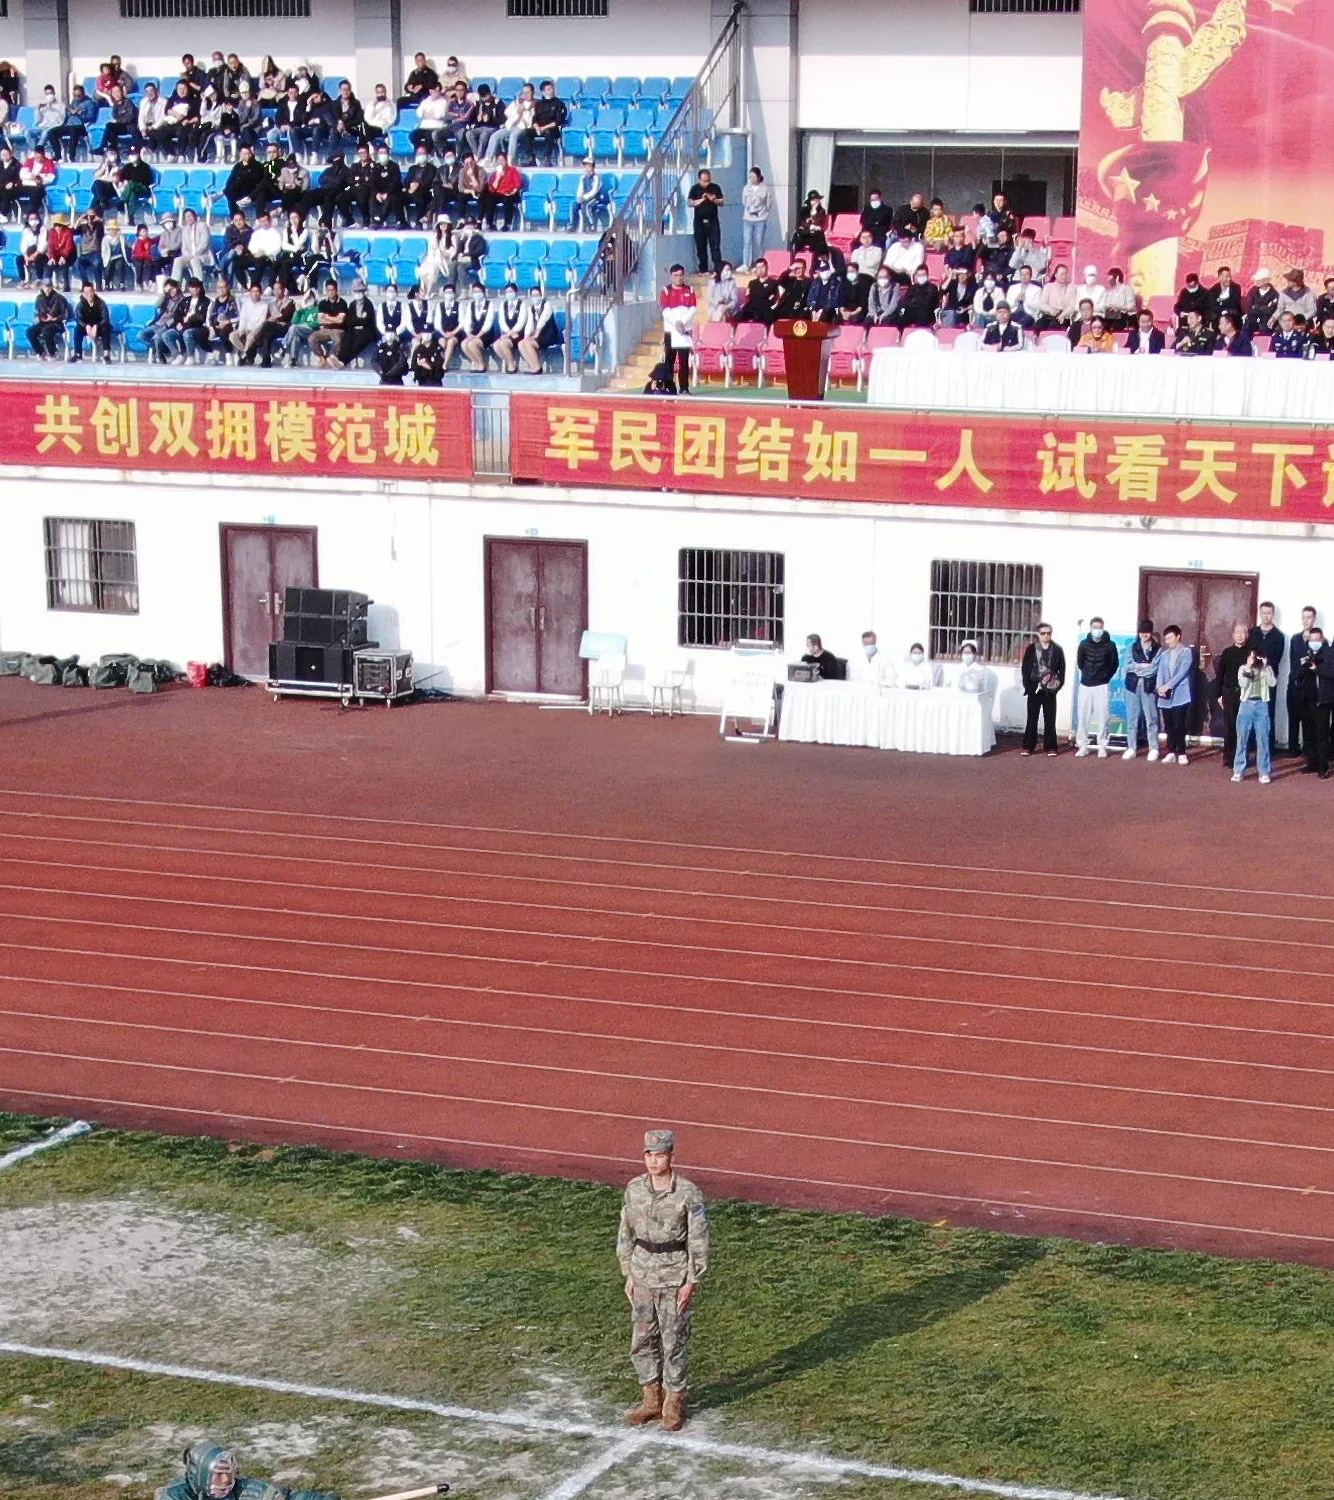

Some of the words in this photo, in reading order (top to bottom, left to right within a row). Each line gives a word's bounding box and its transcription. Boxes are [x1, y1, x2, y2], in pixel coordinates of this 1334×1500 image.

[34, 395, 440, 467] 共创双拥模范城
[545, 406, 993, 493] 军民团结如一人
